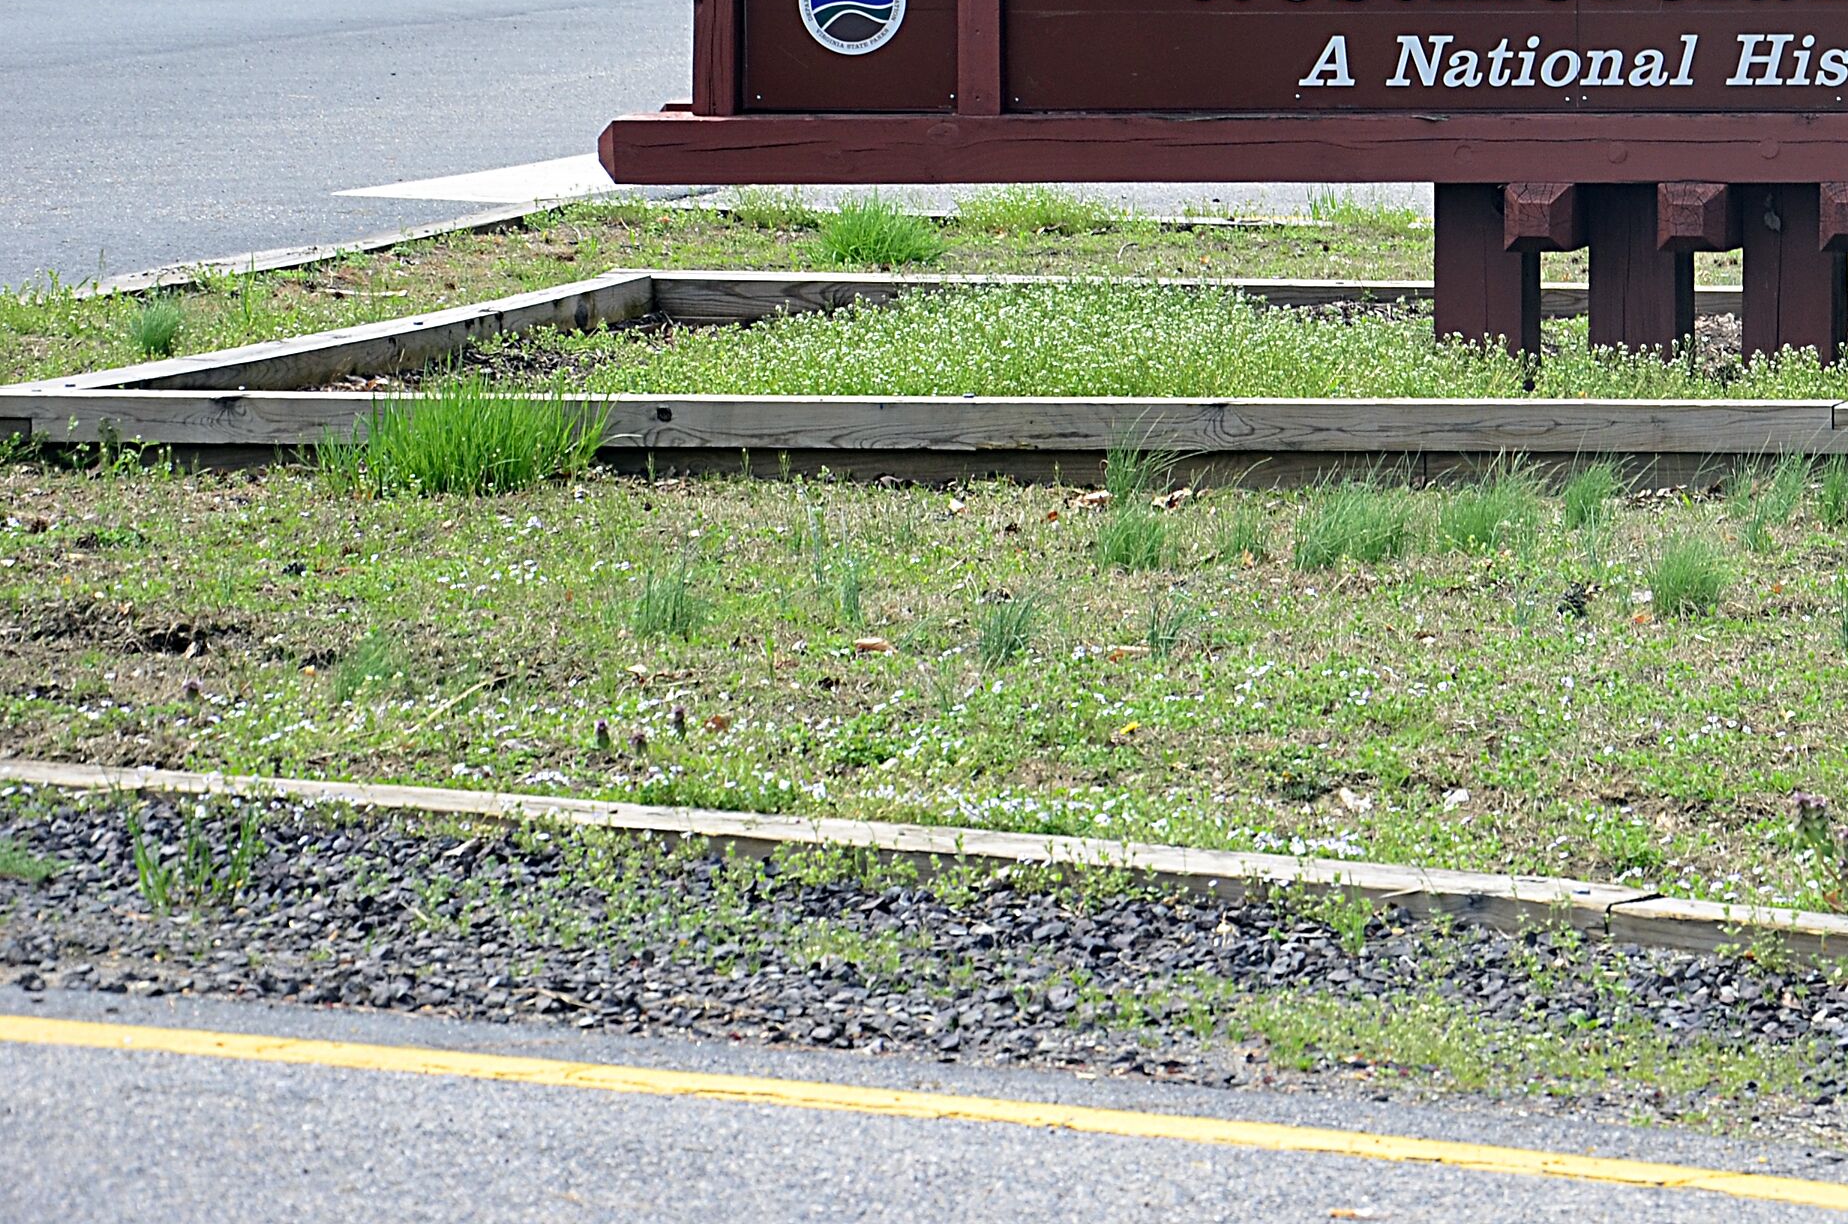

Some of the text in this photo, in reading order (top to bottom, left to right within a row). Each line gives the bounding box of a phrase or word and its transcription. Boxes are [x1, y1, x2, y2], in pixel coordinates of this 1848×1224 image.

[816, 29, 844, 48] VIRGINIA
[870, 28, 889, 44] PARKS
[1299, 34, 1356, 87] A
[1384, 33, 1697, 87] National
